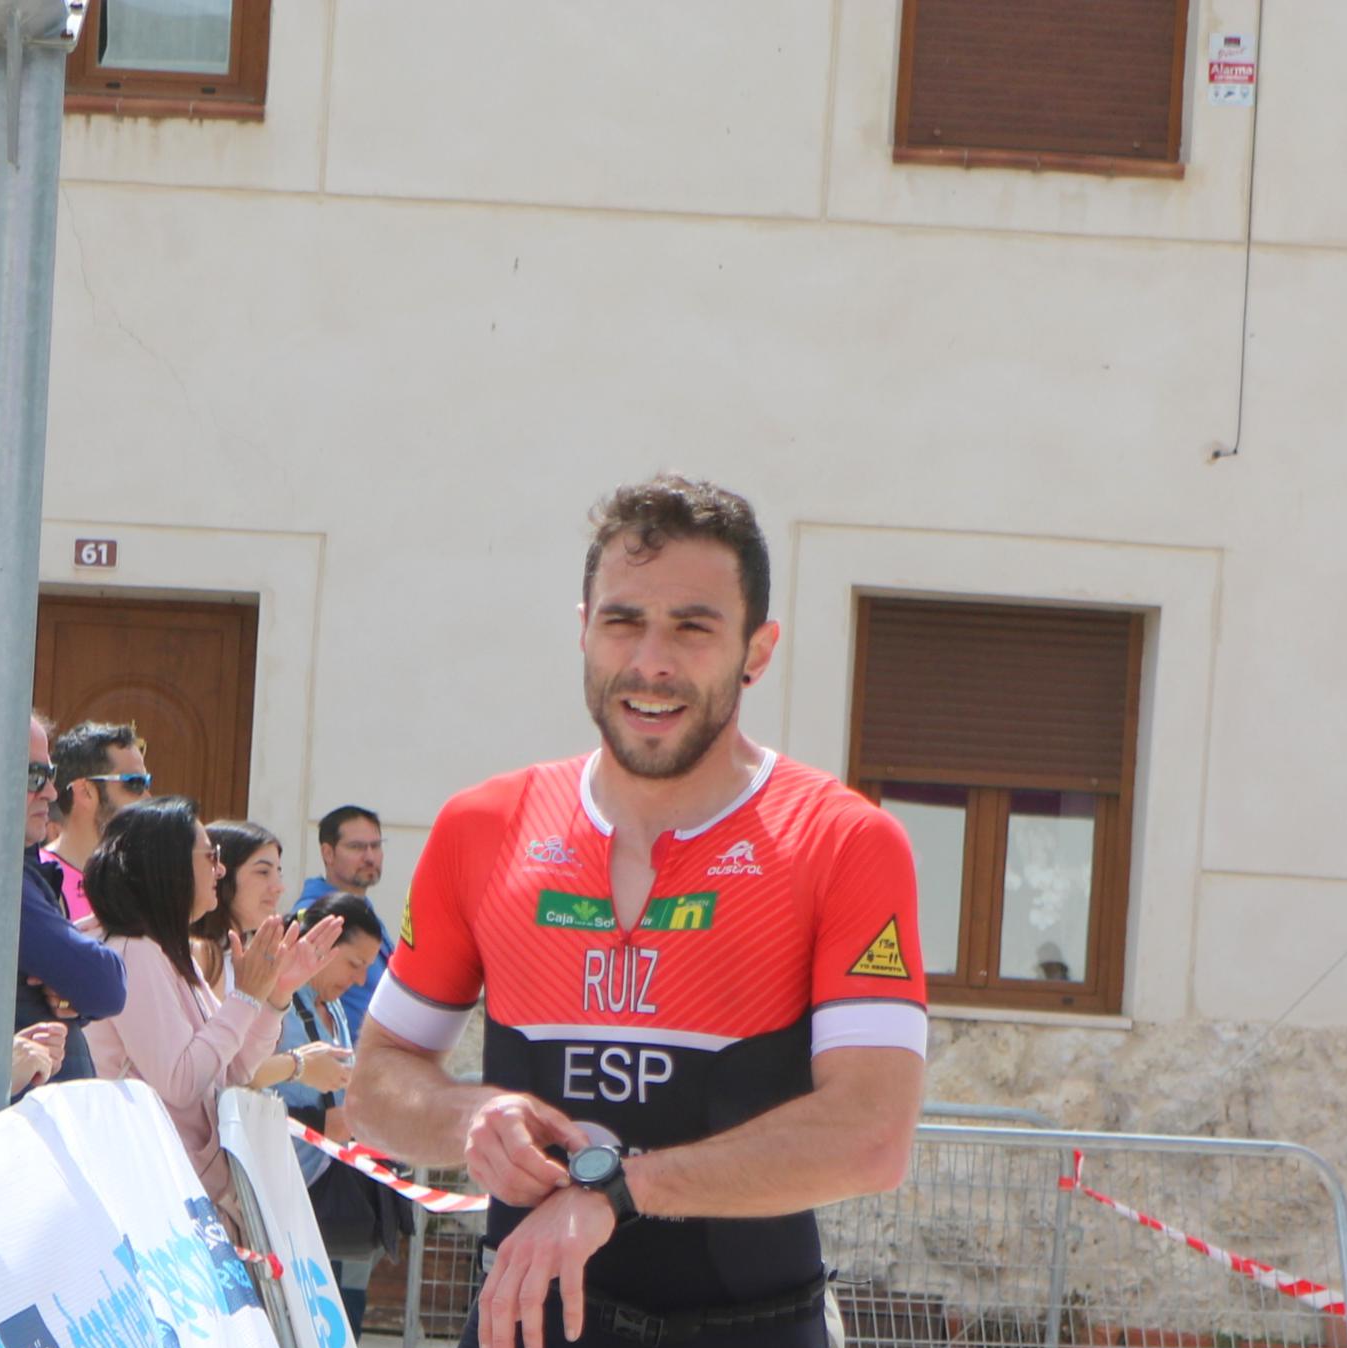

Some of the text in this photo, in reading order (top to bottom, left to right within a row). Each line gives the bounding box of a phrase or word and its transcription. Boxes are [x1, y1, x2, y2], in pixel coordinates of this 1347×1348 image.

[82, 543, 108, 565] 61
[546, 910, 574, 925] Caja
[583, 945, 659, 1015] RUIZ
[563, 1046, 674, 1104] ESP
